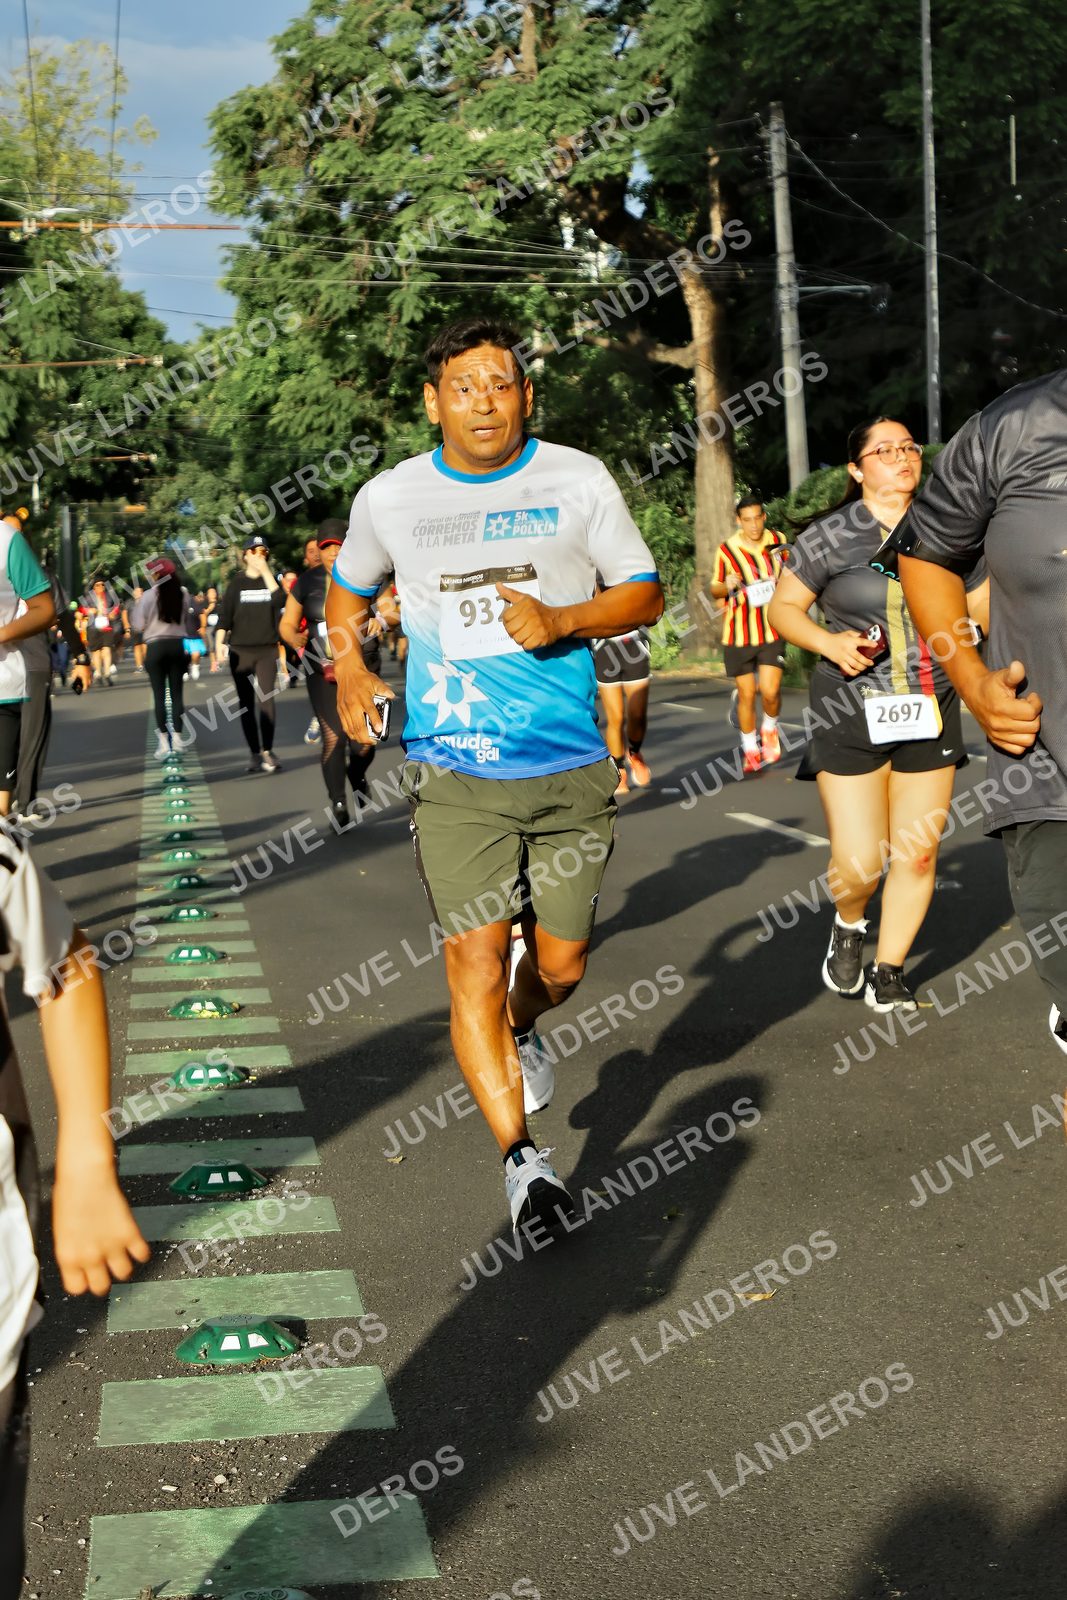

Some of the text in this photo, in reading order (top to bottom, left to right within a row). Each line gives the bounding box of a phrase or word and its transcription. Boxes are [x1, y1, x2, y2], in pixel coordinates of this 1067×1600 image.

[412, 519, 478, 537] CORREMOS
[416, 532, 475, 549] A LA META
[876, 702, 922, 723] 2697
[476, 747, 500, 763] gdl
